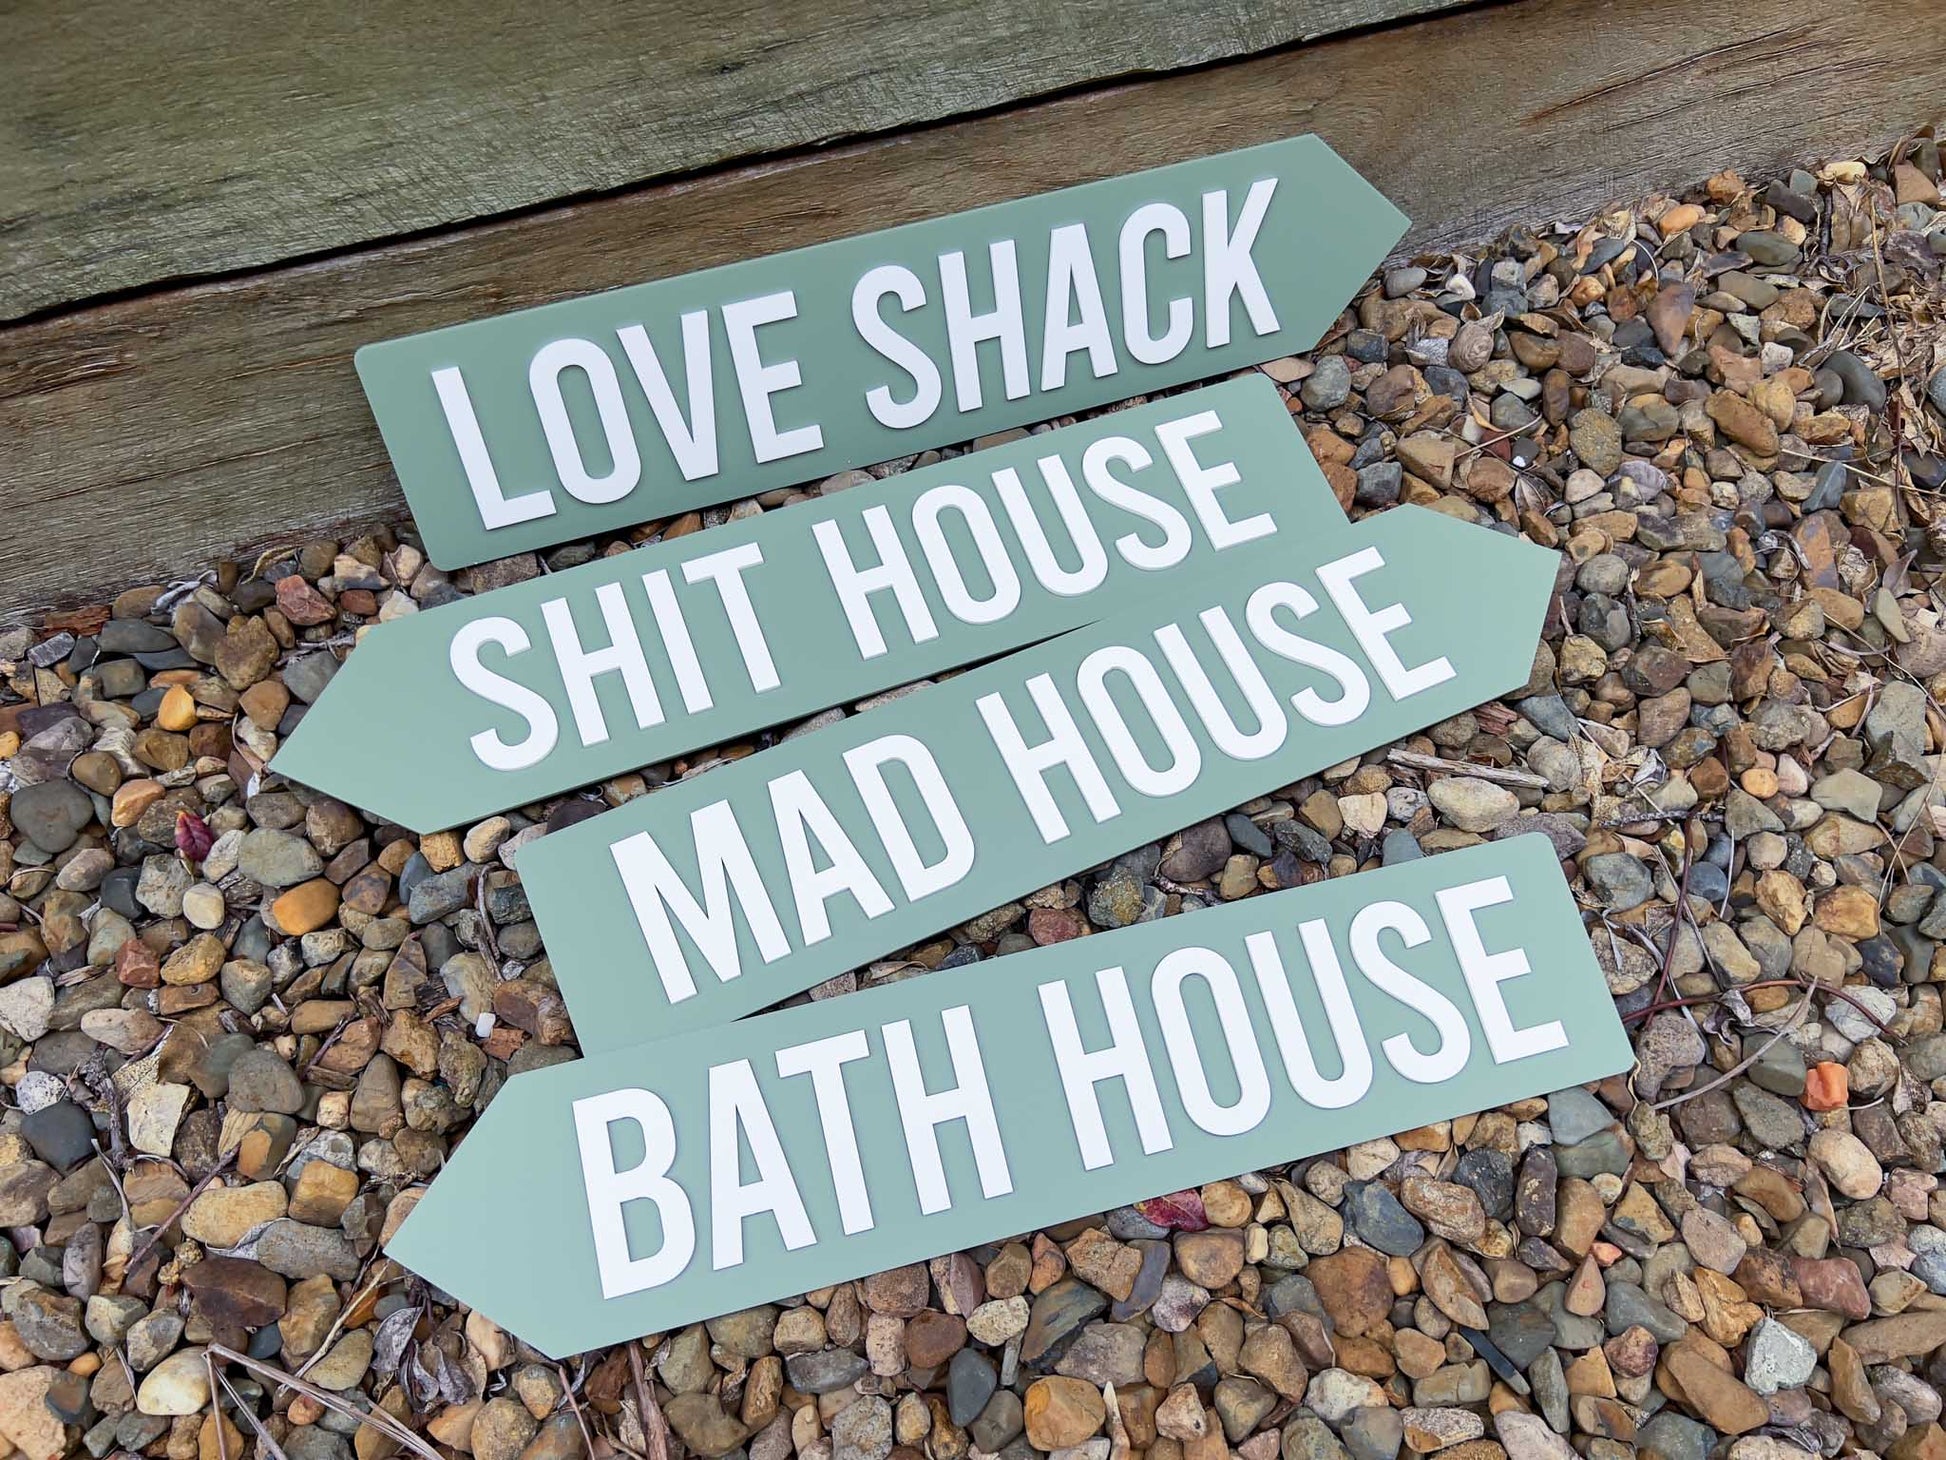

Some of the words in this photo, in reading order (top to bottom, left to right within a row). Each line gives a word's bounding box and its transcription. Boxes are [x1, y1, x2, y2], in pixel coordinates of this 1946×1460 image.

[431, 289, 824, 531] LOVE
[851, 177, 1281, 430] SHACK
[449, 541, 781, 772] SHIT
[811, 409, 1278, 661] HOUSE
[609, 734, 976, 1005] MAD
[975, 545, 1458, 845] HOUSE
[571, 1004, 1014, 1301] BATH
[1037, 874, 1569, 1171] HOUSE
